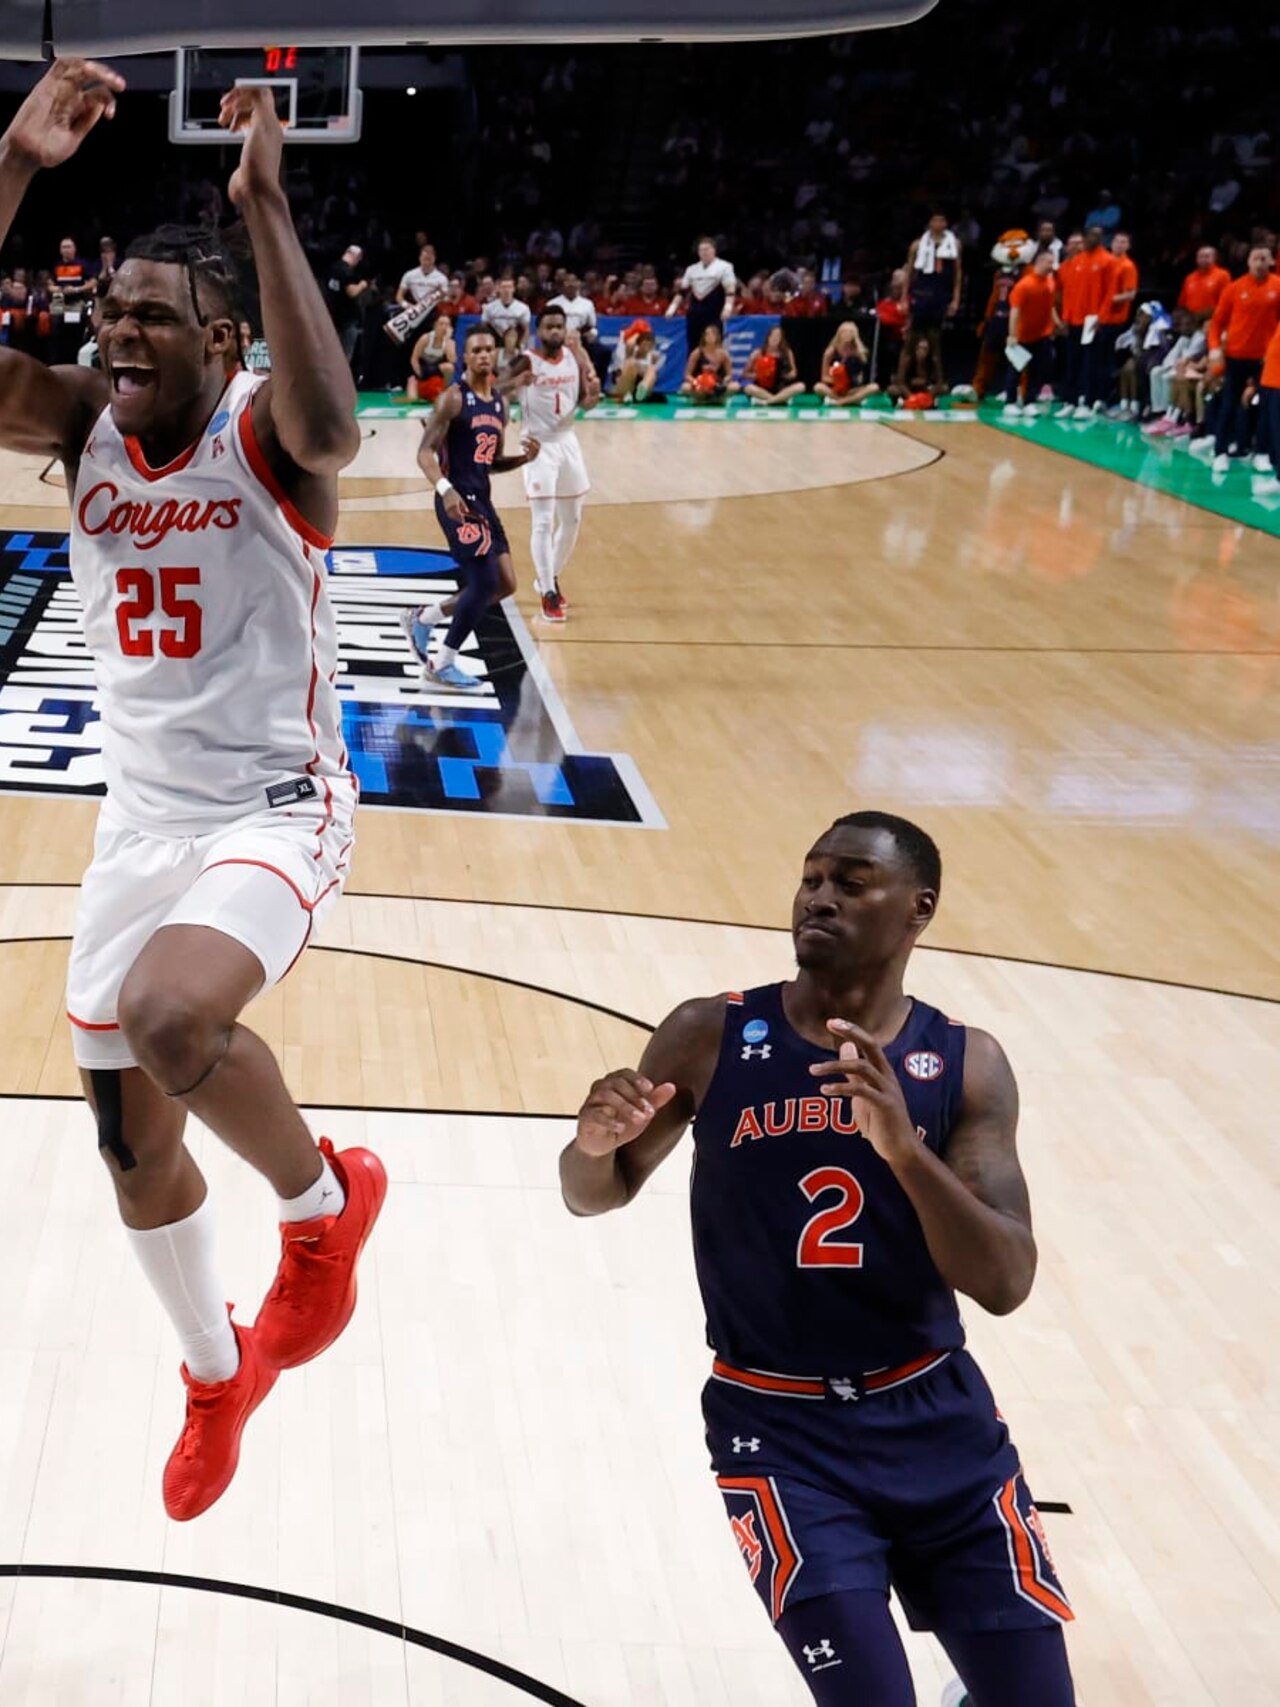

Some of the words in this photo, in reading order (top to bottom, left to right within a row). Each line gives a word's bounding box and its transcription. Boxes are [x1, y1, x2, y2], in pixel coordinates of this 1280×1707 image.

[554, 392, 561, 415] 1
[474, 432, 497, 465] 22
[78, 481, 242, 550] Cougars
[115, 567, 202, 658] 25
[908, 1053, 940, 1079] SEC
[730, 1097, 926, 1148] AUBU
[797, 1166, 864, 1268] 2
